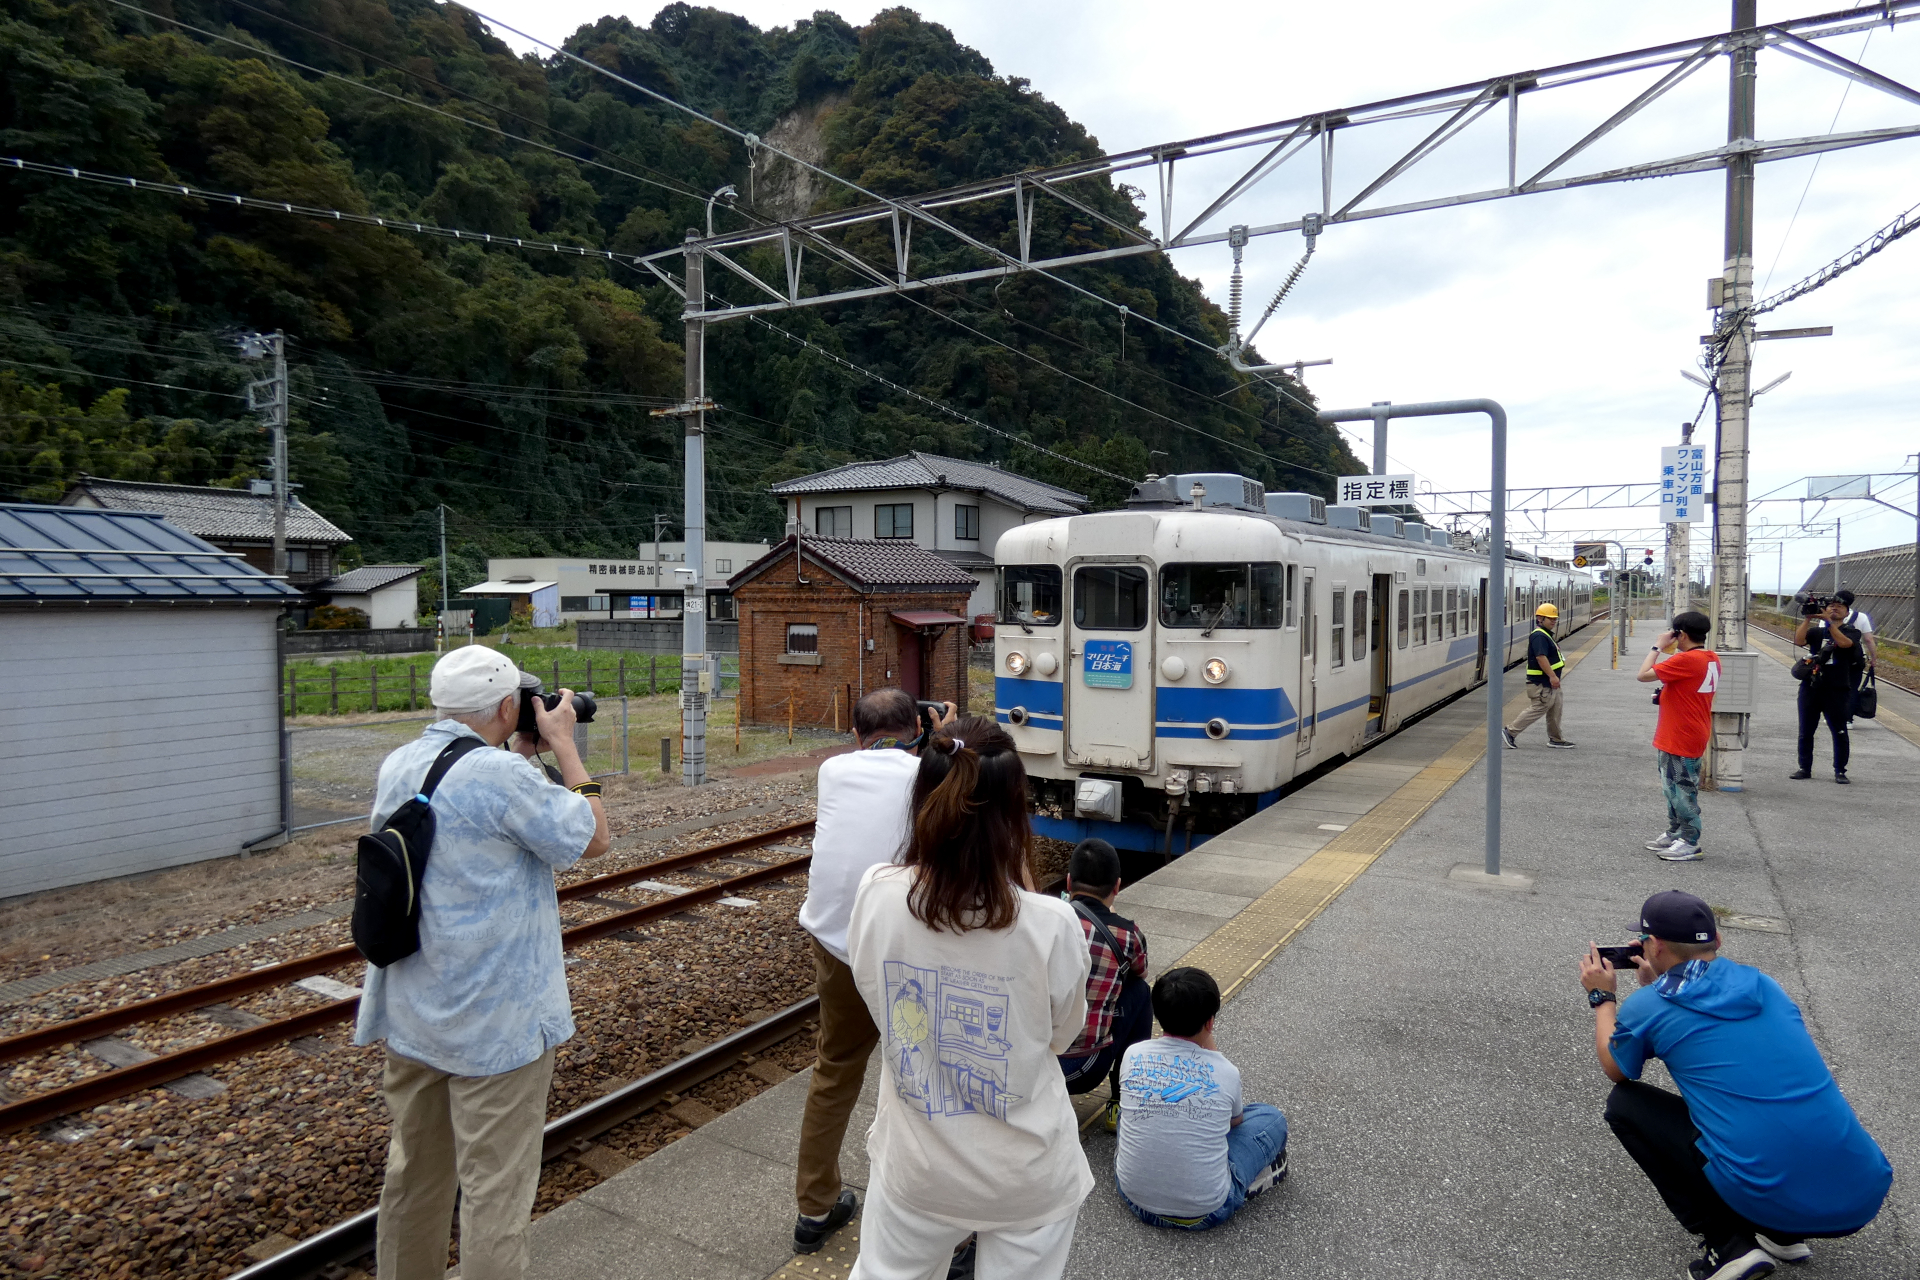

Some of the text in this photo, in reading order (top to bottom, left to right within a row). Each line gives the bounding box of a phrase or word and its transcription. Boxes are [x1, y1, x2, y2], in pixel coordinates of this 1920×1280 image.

[1690, 448, 1703, 495] 富山方面
[1343, 480, 1409, 501] 指定標
[1662, 465, 1674, 503] 乗車口
[1675, 449, 1689, 518] ワンマン列車
[1577, 558, 1583, 566] 2
[1091, 661, 1122, 671] 日本海
[940, 965, 961, 974] BECOME
[972, 971, 987, 979] ORDER
[983, 984, 999, 992] BETTER
